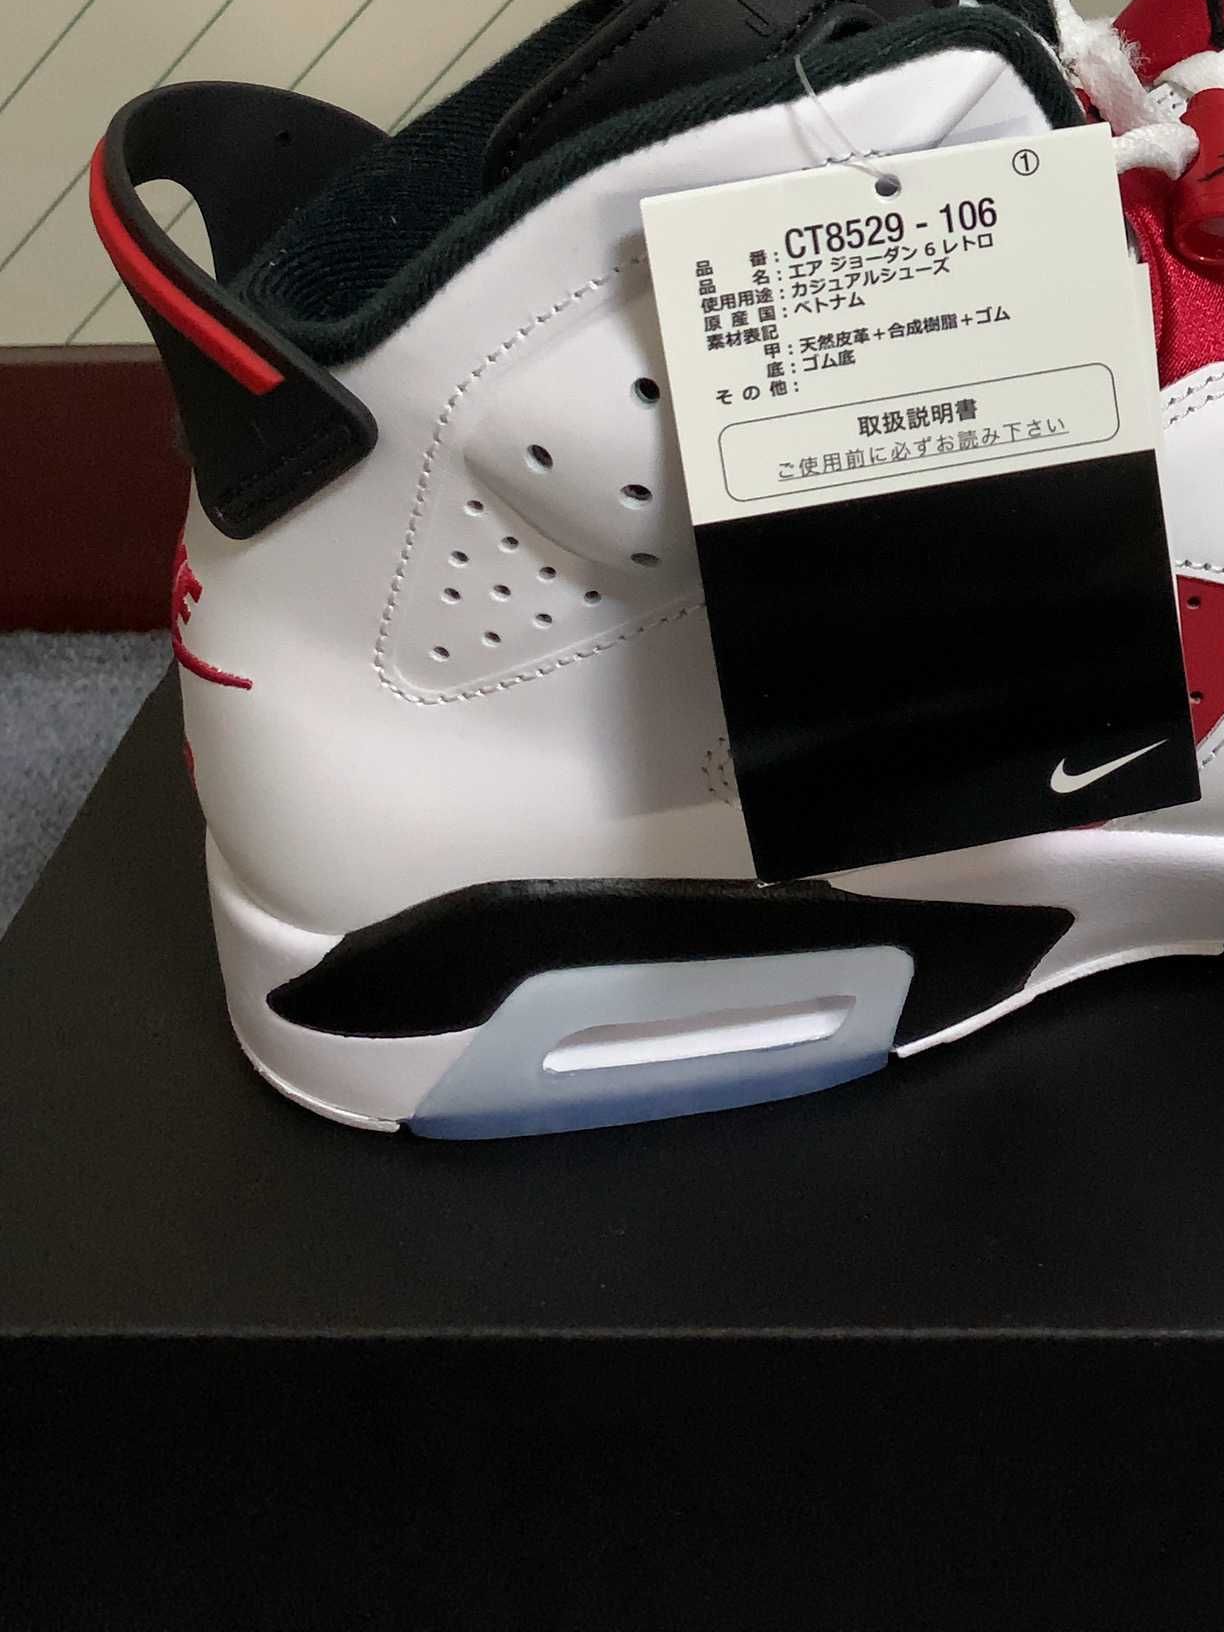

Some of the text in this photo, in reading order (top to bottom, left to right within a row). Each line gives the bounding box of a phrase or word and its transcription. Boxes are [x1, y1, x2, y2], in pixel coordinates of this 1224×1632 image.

[784, 212, 905, 259] CT8529
[939, 197, 998, 233] 106
[788, 259, 823, 280] エア
[830, 245, 917, 273] ジョーダン
[925, 242, 936, 257] 6
[943, 233, 993, 254] レトロ
[793, 292, 866, 314] ベトナム
[706, 324, 779, 351] 素材表記
[802, 349, 857, 372] ゴム底
[857, 398, 978, 438] 取扱説明書
[778, 418, 1066, 479] ご使用前に必ずお読み下さい
